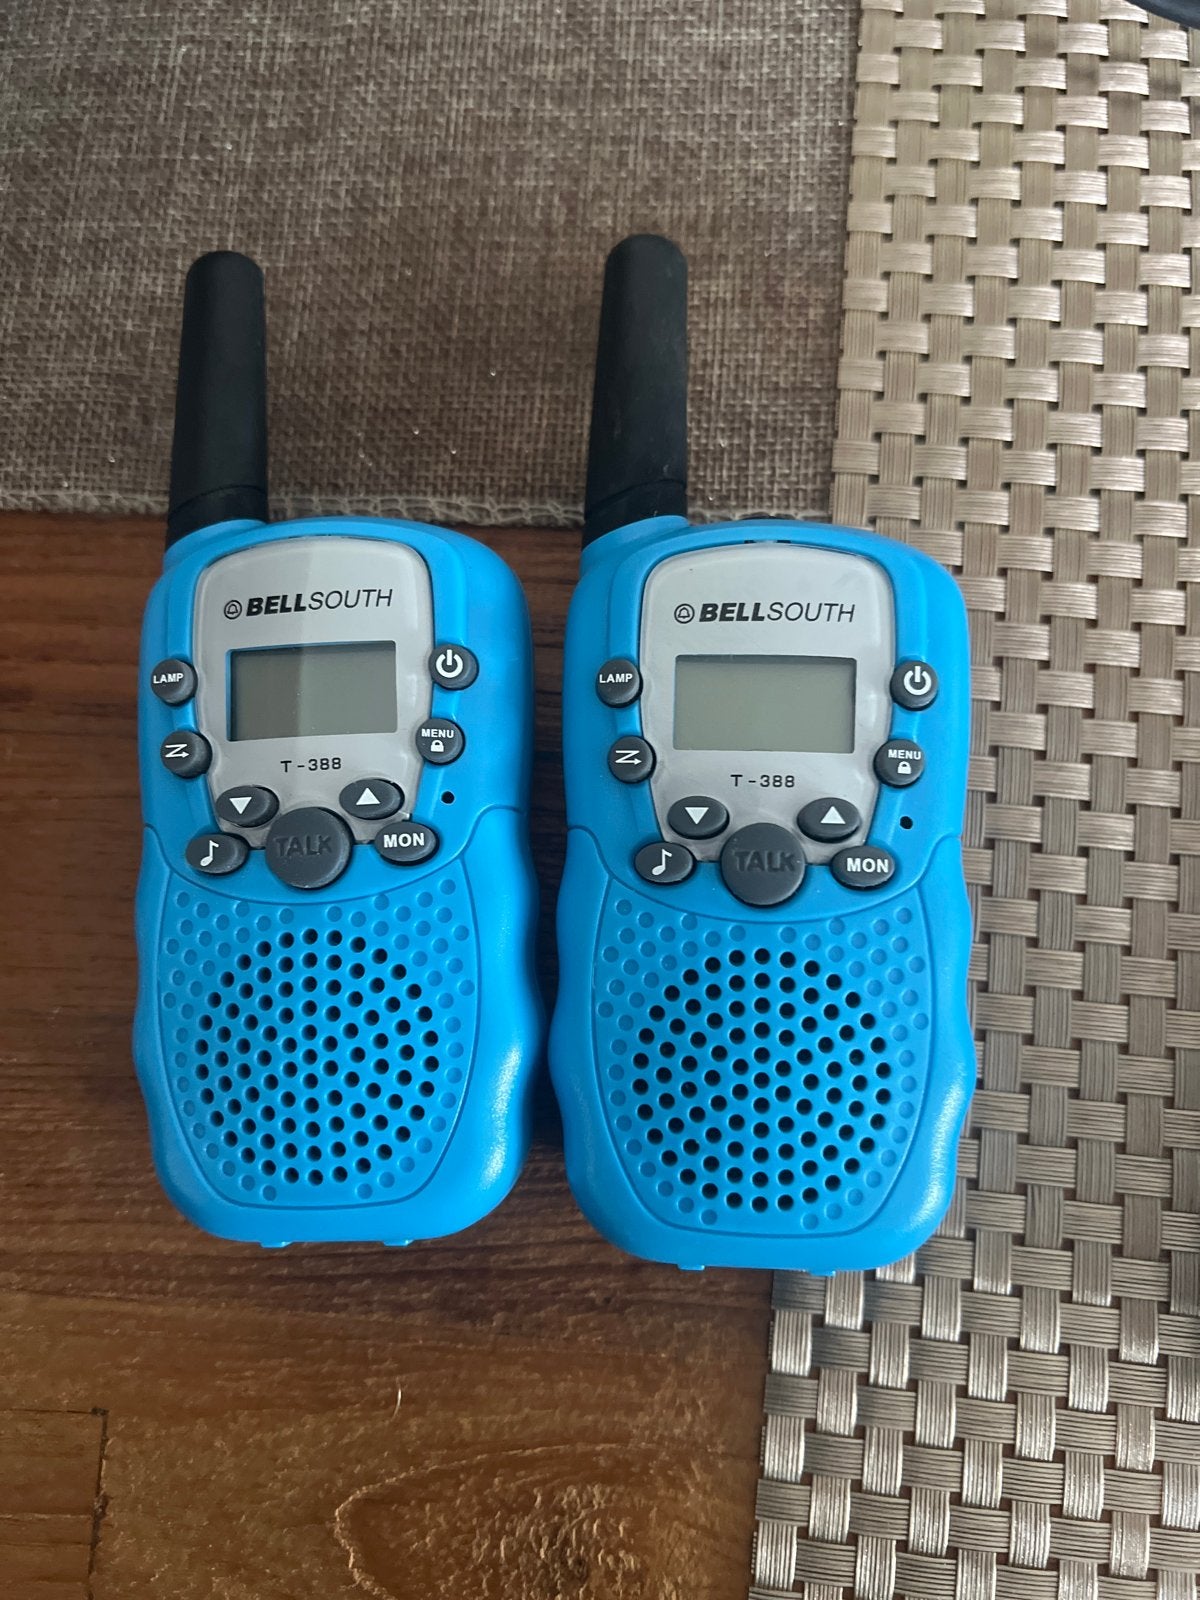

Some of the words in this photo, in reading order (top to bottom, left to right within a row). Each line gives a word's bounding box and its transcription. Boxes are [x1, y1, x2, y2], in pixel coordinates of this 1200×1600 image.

[246, 589, 393, 617] BELLSOUTH
[699, 602, 856, 623] BELLSOUTH
[153, 672, 184, 684] LAMP
[599, 672, 633, 684] LAMP
[421, 727, 455, 740] MENU
[888, 749, 922, 761] MENU
[280, 757, 342, 773] T-388
[730, 774, 796, 789] T-388
[274, 835, 333, 858] TALK
[383, 832, 425, 849] MON
[733, 849, 796, 873] TALK
[846, 857, 889, 874] MON
